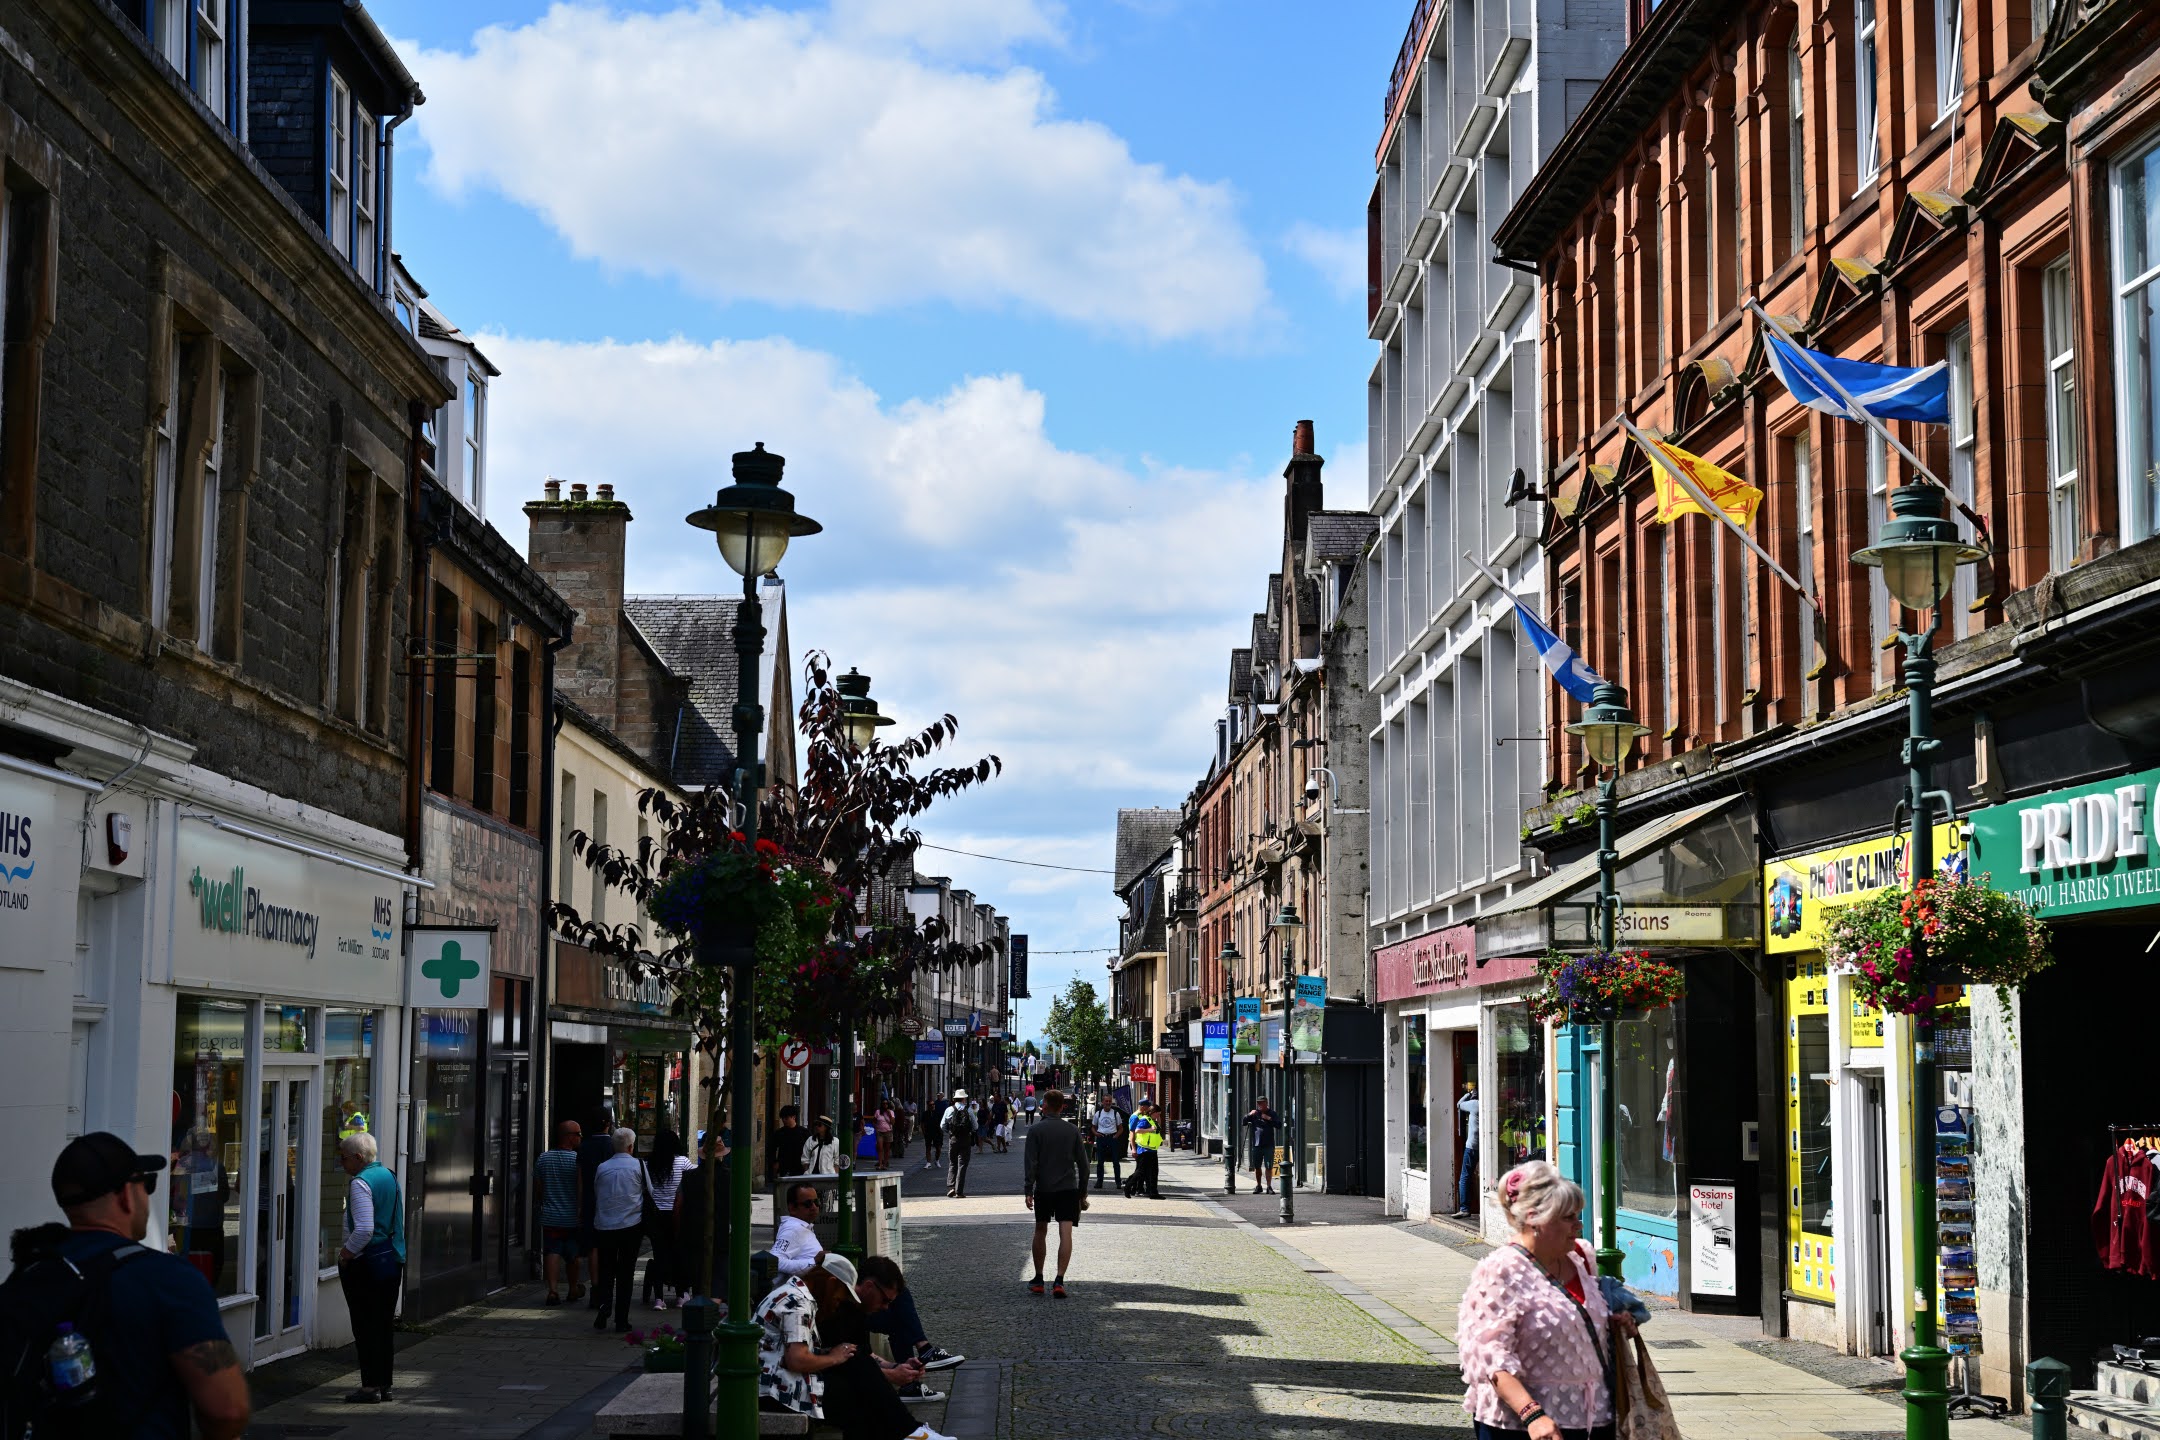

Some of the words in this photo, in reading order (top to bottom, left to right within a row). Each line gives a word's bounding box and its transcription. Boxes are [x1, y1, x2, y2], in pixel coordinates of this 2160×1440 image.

[2019, 784, 2148, 874] PRIDE
[1809, 858, 1853, 899] PHONE
[2059, 875, 2109, 906] HARRIS
[202, 865, 244, 934] well
[246, 886, 319, 959] Pharmacy
[374, 896, 392, 926] NHS
[440, 1008, 469, 1035] sonas
[1205, 1025, 1216, 1035] TO
[1217, 1025, 1229, 1035] LET
[1692, 1188, 1733, 1200] Ossians
[1701, 1200, 1723, 1210] Hotel
